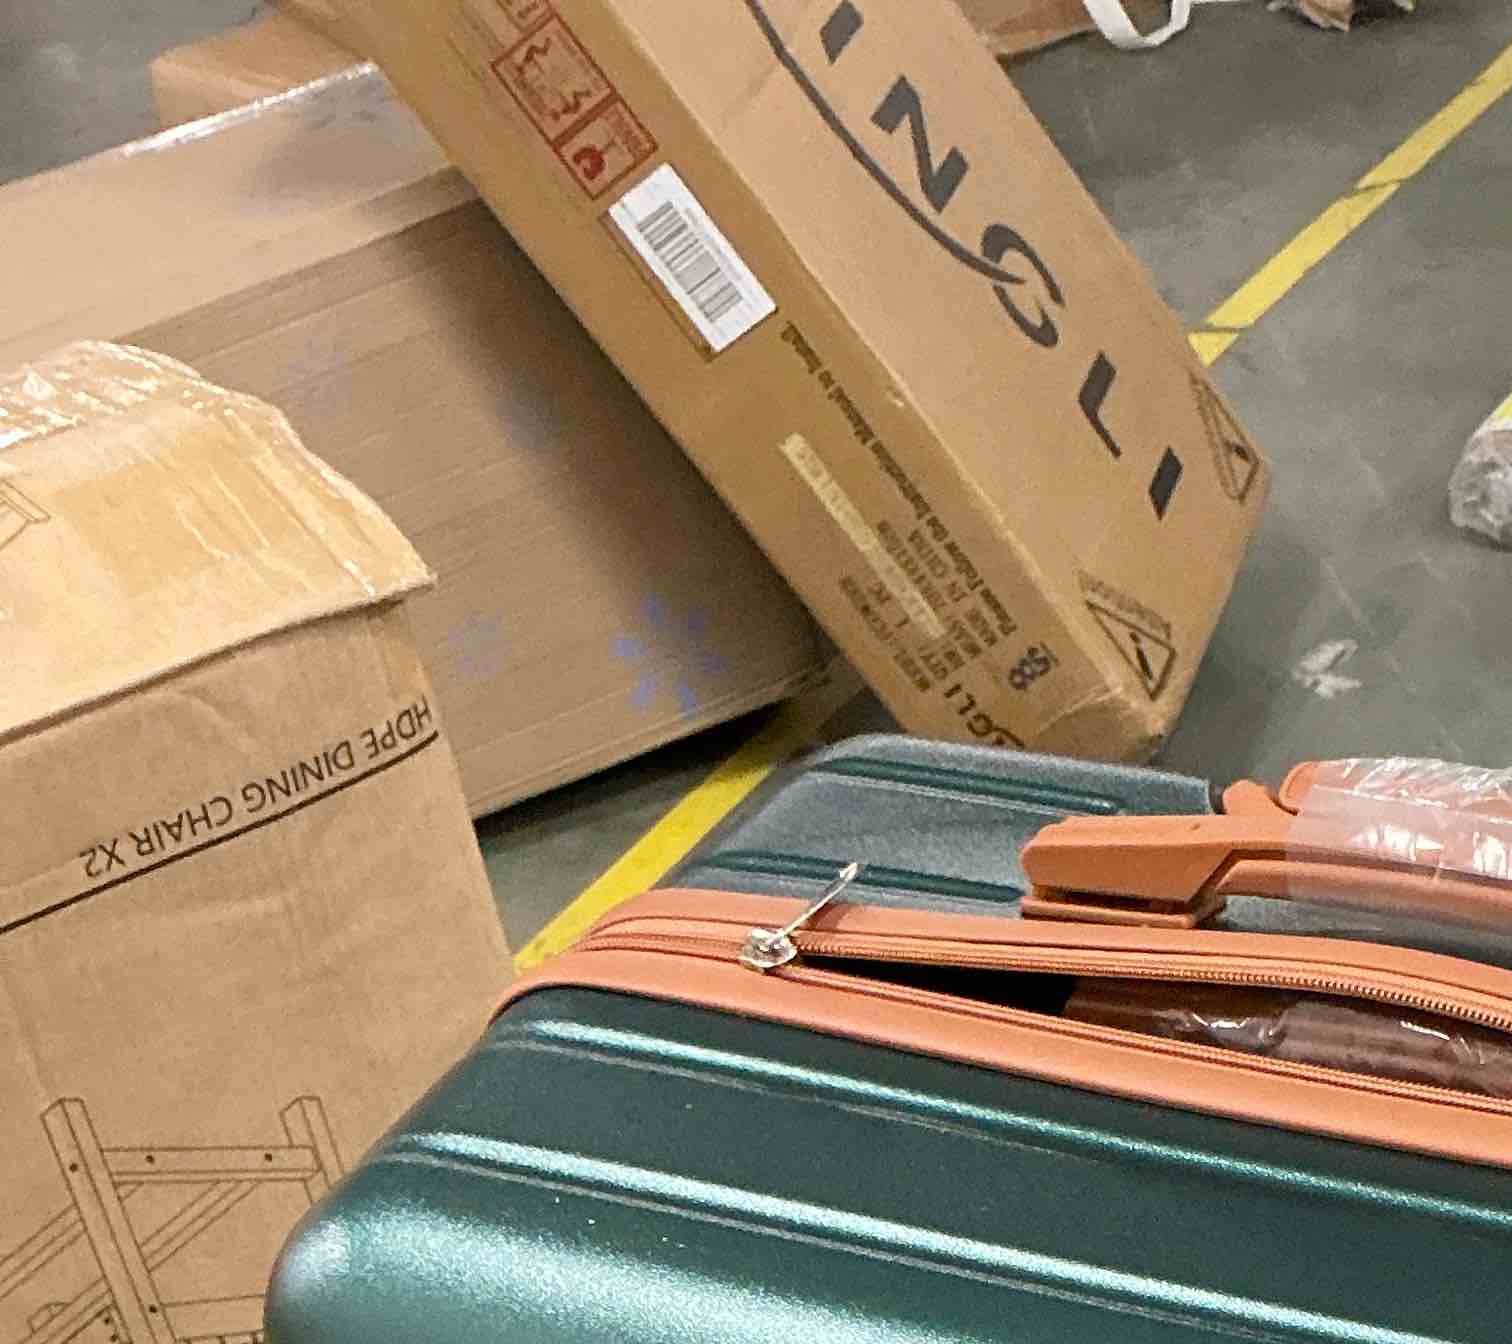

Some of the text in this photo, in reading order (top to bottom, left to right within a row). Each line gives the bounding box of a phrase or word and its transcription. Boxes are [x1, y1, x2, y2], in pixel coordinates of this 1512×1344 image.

[79, 695, 433, 878] HDPE DINING CHAIR X2
